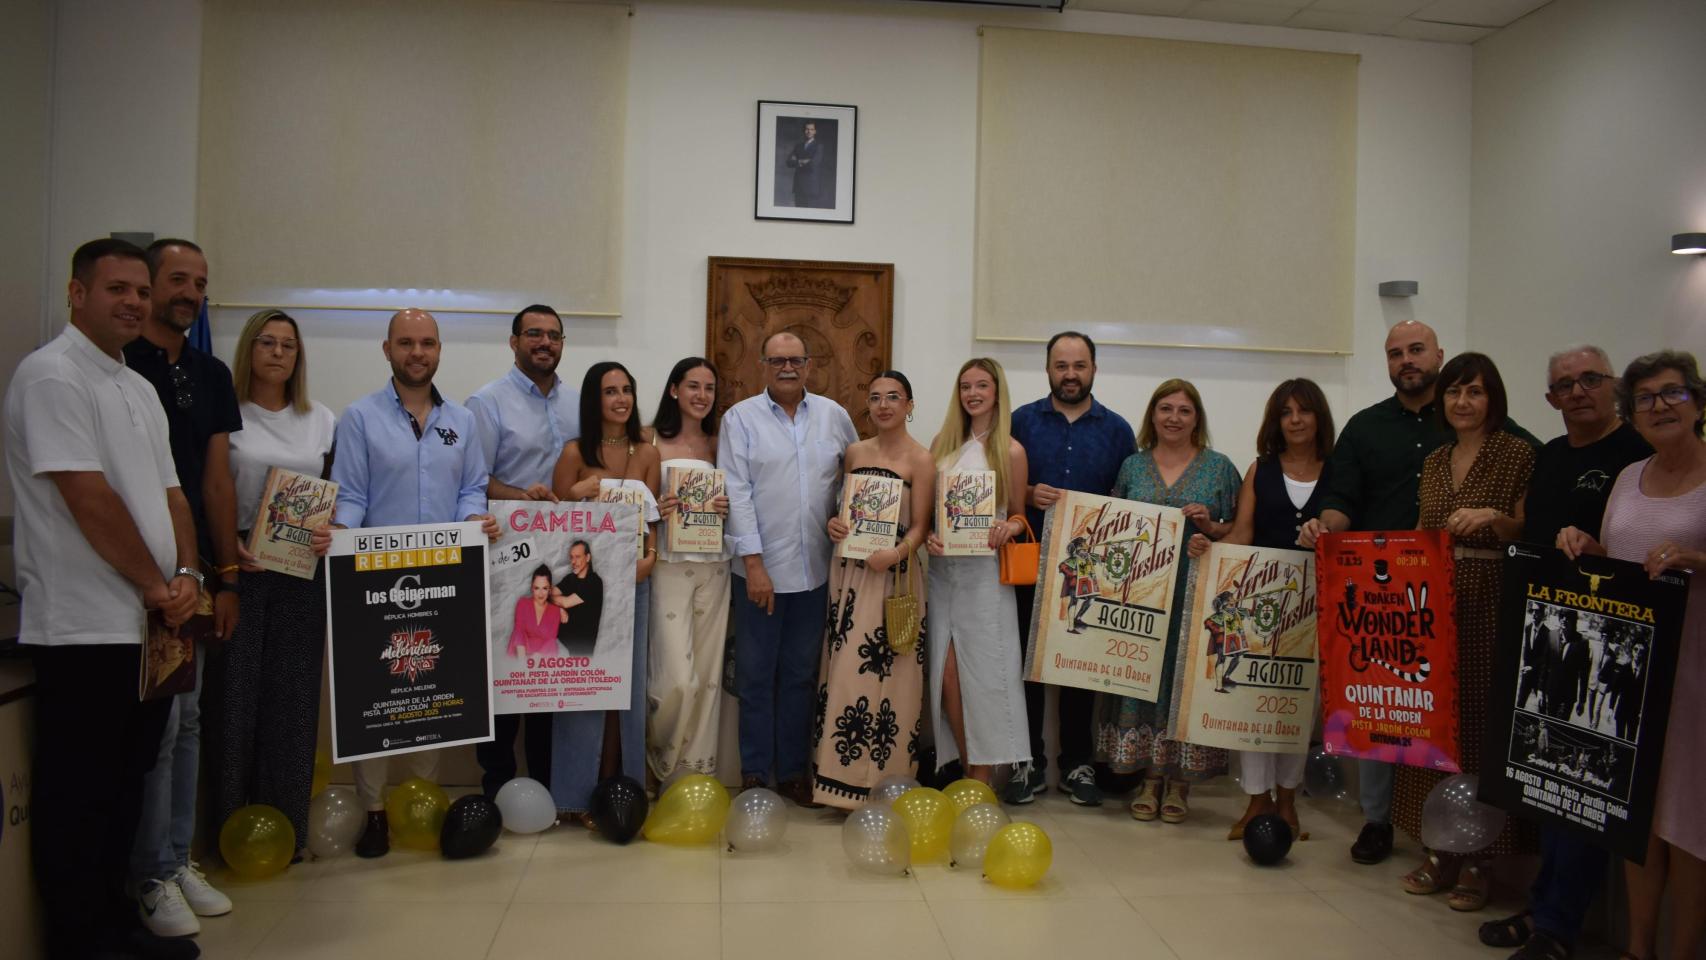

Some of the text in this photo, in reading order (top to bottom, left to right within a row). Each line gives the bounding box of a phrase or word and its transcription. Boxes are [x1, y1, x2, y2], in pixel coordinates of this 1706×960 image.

[510, 509, 617, 533] CAMELA
[693, 514, 716, 524] AGOSTO
[866, 521, 891, 534] AGOSTO
[964, 517, 989, 526] AGOSTO
[870, 536, 889, 546] 2025
[359, 550, 459, 568] REPLICA
[511, 542, 530, 562] 30
[1396, 556, 1418, 567] 00:30
[365, 585, 456, 604] Los Geiperman
[1363, 591, 1405, 606] KRAKEN
[1527, 583, 1656, 623] LA FRONTERA
[1097, 605, 1155, 634] AGOSTO
[1338, 602, 1435, 639] WONDER
[1105, 638, 1150, 662] 2025
[1361, 636, 1416, 665] LAND
[527, 657, 590, 669] 9 AGOSTO
[493, 679, 536, 687] QUINTANAR
[588, 676, 621, 684] (TOLEDO)
[551, 669, 578, 677] JARDÍN
[580, 668, 605, 676] COLÓN
[1246, 660, 1303, 685] AGOSTO
[373, 699, 410, 710] QUINTANAR
[432, 693, 455, 701] ORDEN
[1256, 695, 1298, 714] 2025
[1345, 684, 1434, 712] QUINTANAR
[363, 709, 381, 718] PISTA
[383, 706, 405, 715] JARDÍN
[407, 703, 428, 711] COLÓN
[442, 698, 464, 706] HORAS
[397, 711, 422, 720] AGOSTO
[1359, 706, 1421, 723] DE LA ORDEN
[1351, 720, 1431, 738] PISTA JARDÍN COLÓN
[1506, 766, 1514, 778] 16
[1514, 769, 1542, 787] AGOSTO
[1560, 784, 1579, 801] Pista
[1580, 792, 1606, 811] Jardín
[1606, 802, 1628, 820] Colón
[1523, 784, 1561, 807] QUINTANAR
[1562, 797, 1572, 811] DE
[1572, 801, 1581, 815] LA
[1582, 805, 1607, 824] ORDEN
